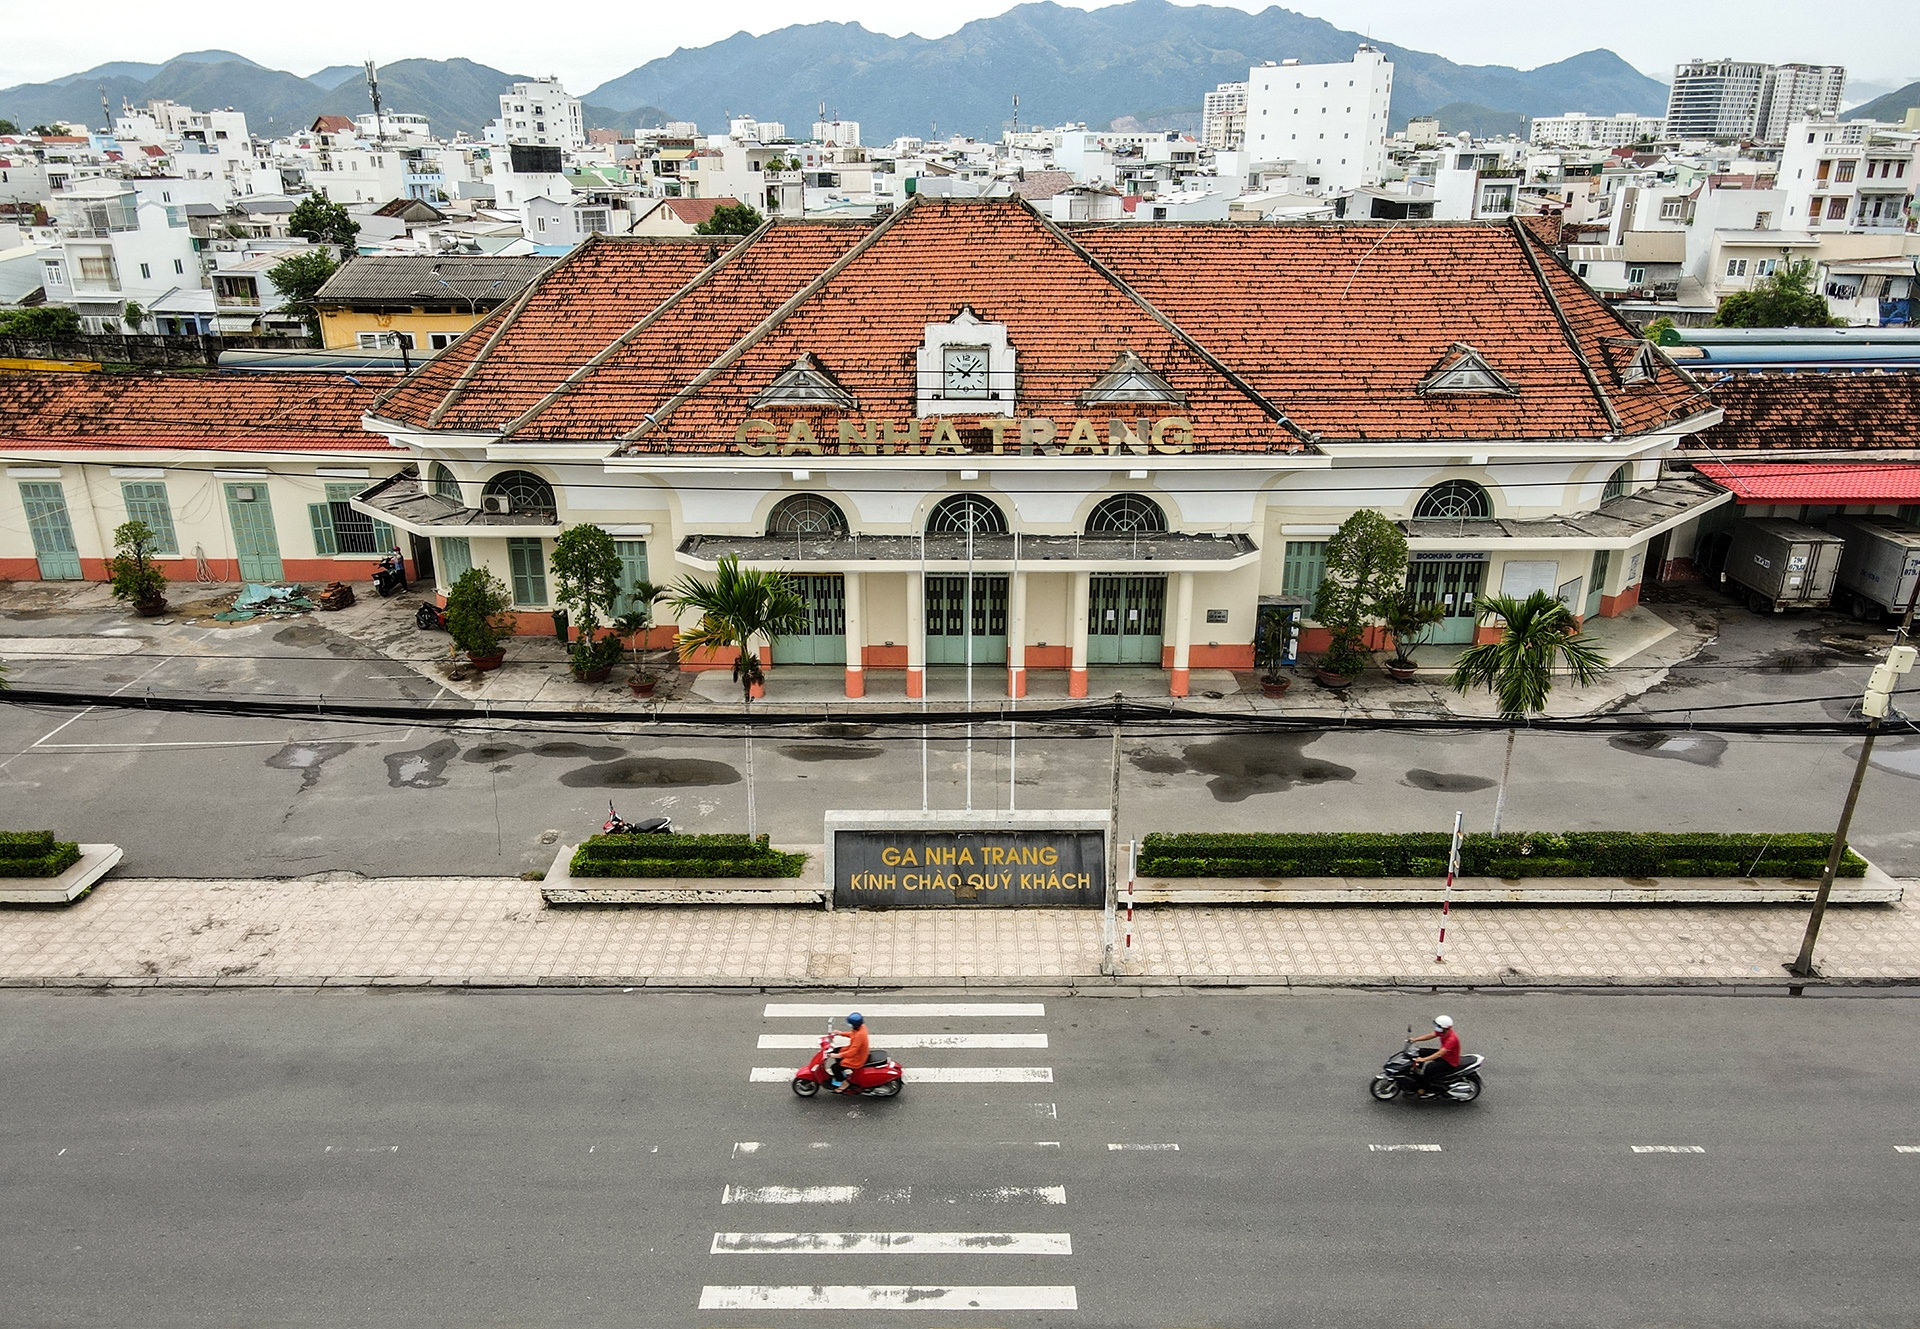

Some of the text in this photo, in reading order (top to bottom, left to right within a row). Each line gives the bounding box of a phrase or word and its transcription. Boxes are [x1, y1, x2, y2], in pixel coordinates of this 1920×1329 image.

[734, 417, 1194, 457] GA NHA TRANG
[1416, 552, 1484, 560] BOOKING OFFICE
[881, 846, 1059, 867] GA NHA TRANG
[850, 869, 1091, 891] KÍNH CHÀO QUÝ KHÁCH
